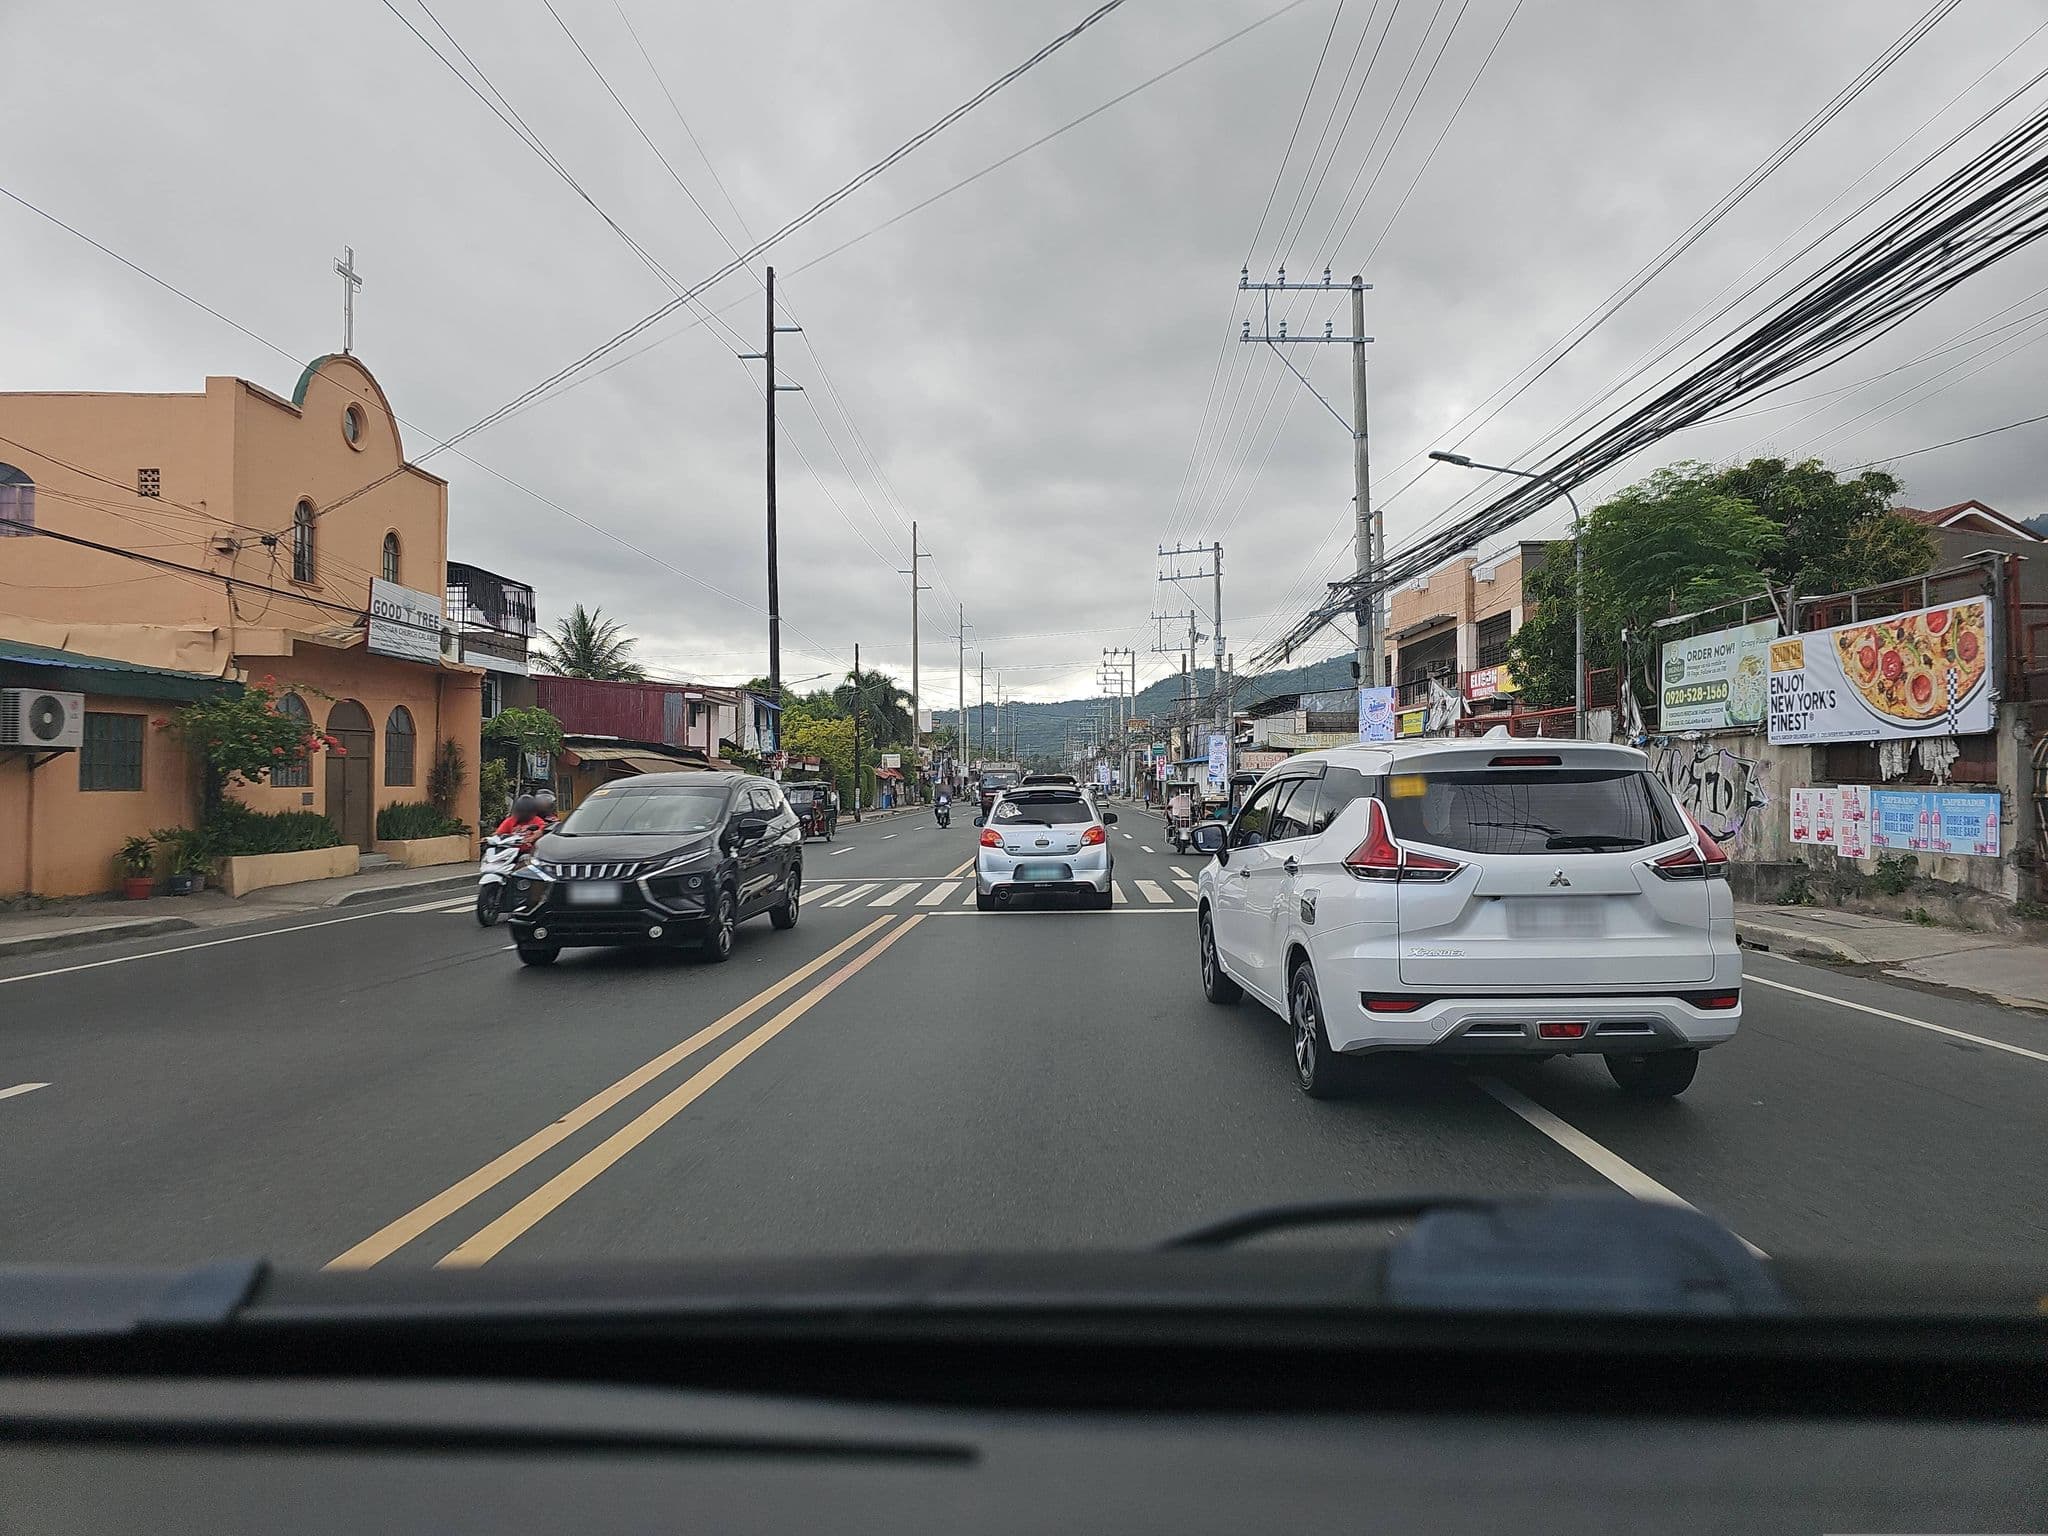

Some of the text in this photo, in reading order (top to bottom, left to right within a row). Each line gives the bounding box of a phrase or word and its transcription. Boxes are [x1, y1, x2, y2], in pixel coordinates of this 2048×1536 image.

[374, 599, 440, 629] GOOD TREE
[399, 627, 418, 639] CHURCH
[1686, 642, 1736, 662] ORDER NOW!
[1470, 668, 1497, 689] ELISON
[1770, 674, 1804, 695] ENJOY
[1665, 683, 1728, 706] 0920-528-1568
[1771, 689, 1836, 713] NEW YORK'S
[1407, 946, 1466, 958] XPANDER
